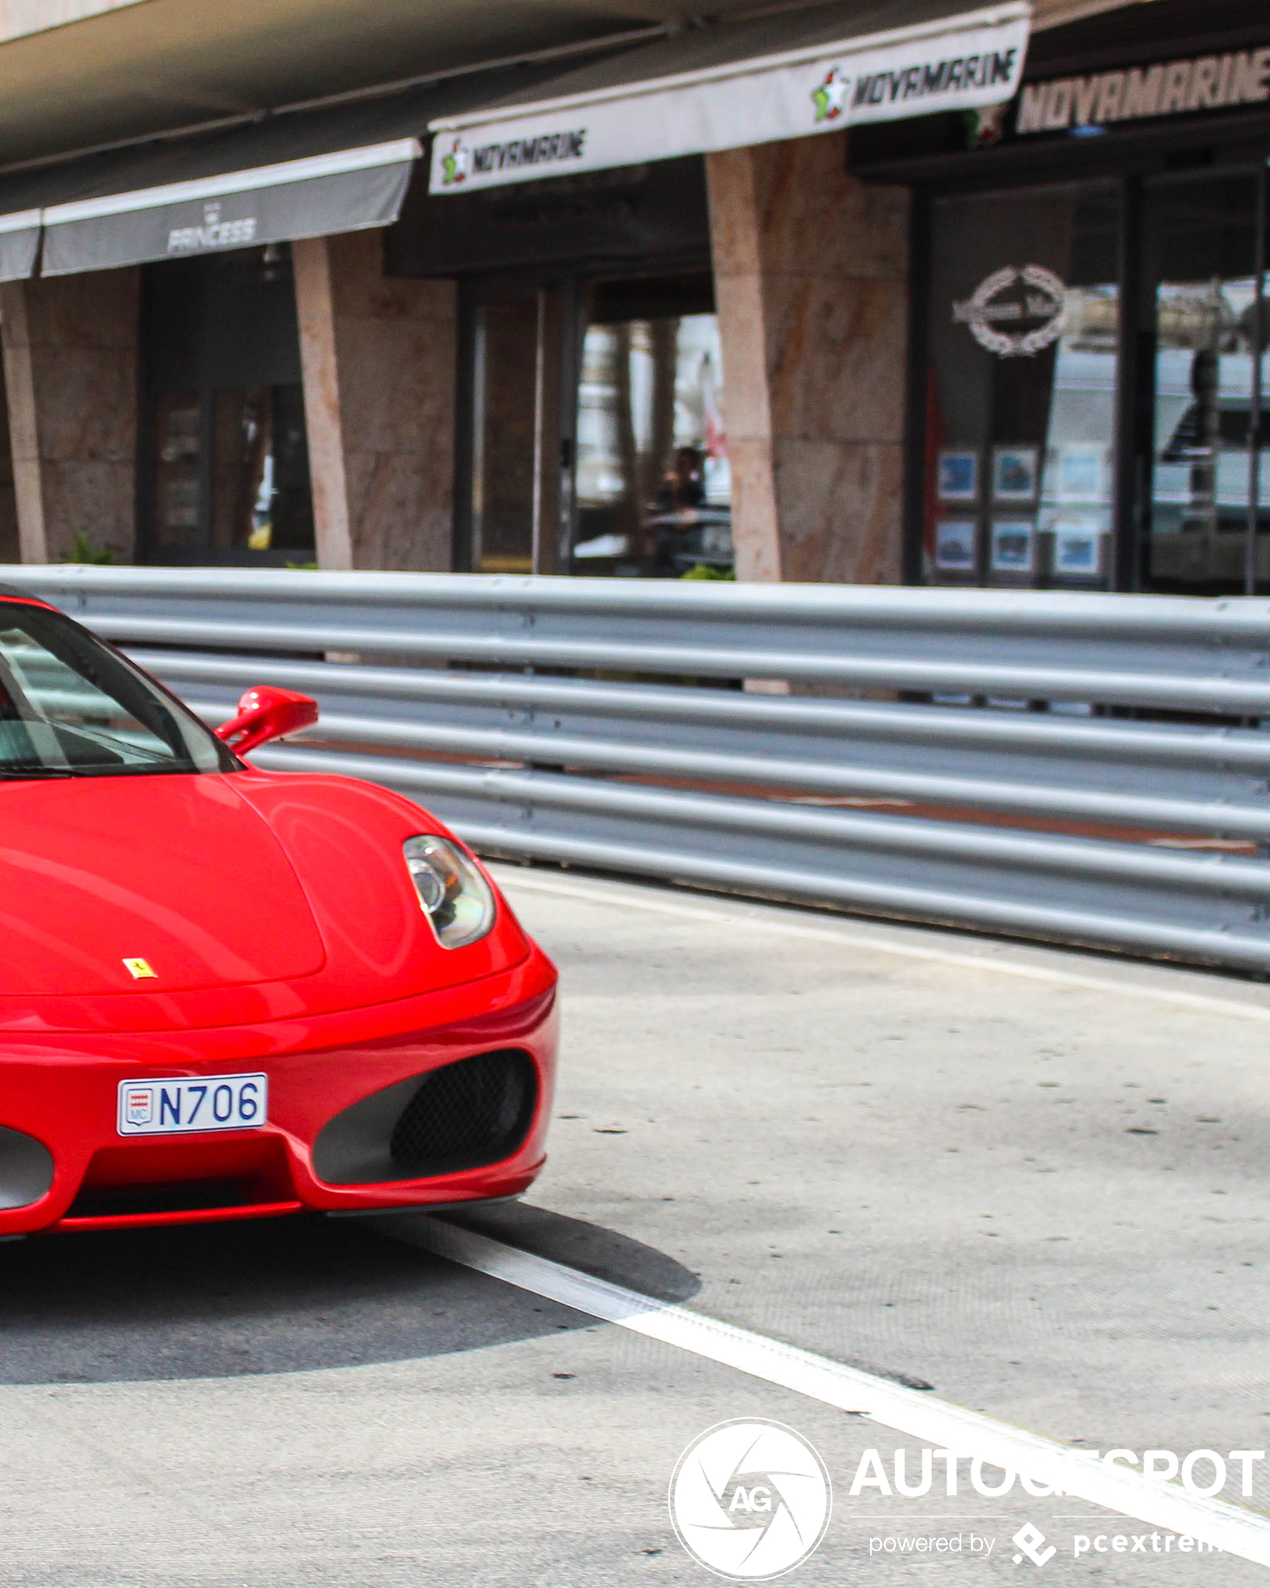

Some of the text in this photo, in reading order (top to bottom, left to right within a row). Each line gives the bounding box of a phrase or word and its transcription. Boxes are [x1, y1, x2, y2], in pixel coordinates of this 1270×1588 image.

[851, 48, 1018, 108] NOVAMARINE
[1015, 46, 1270, 135] NOVAMARINE
[167, 217, 257, 253] PRINCESS
[160, 1083, 258, 1125] N706
